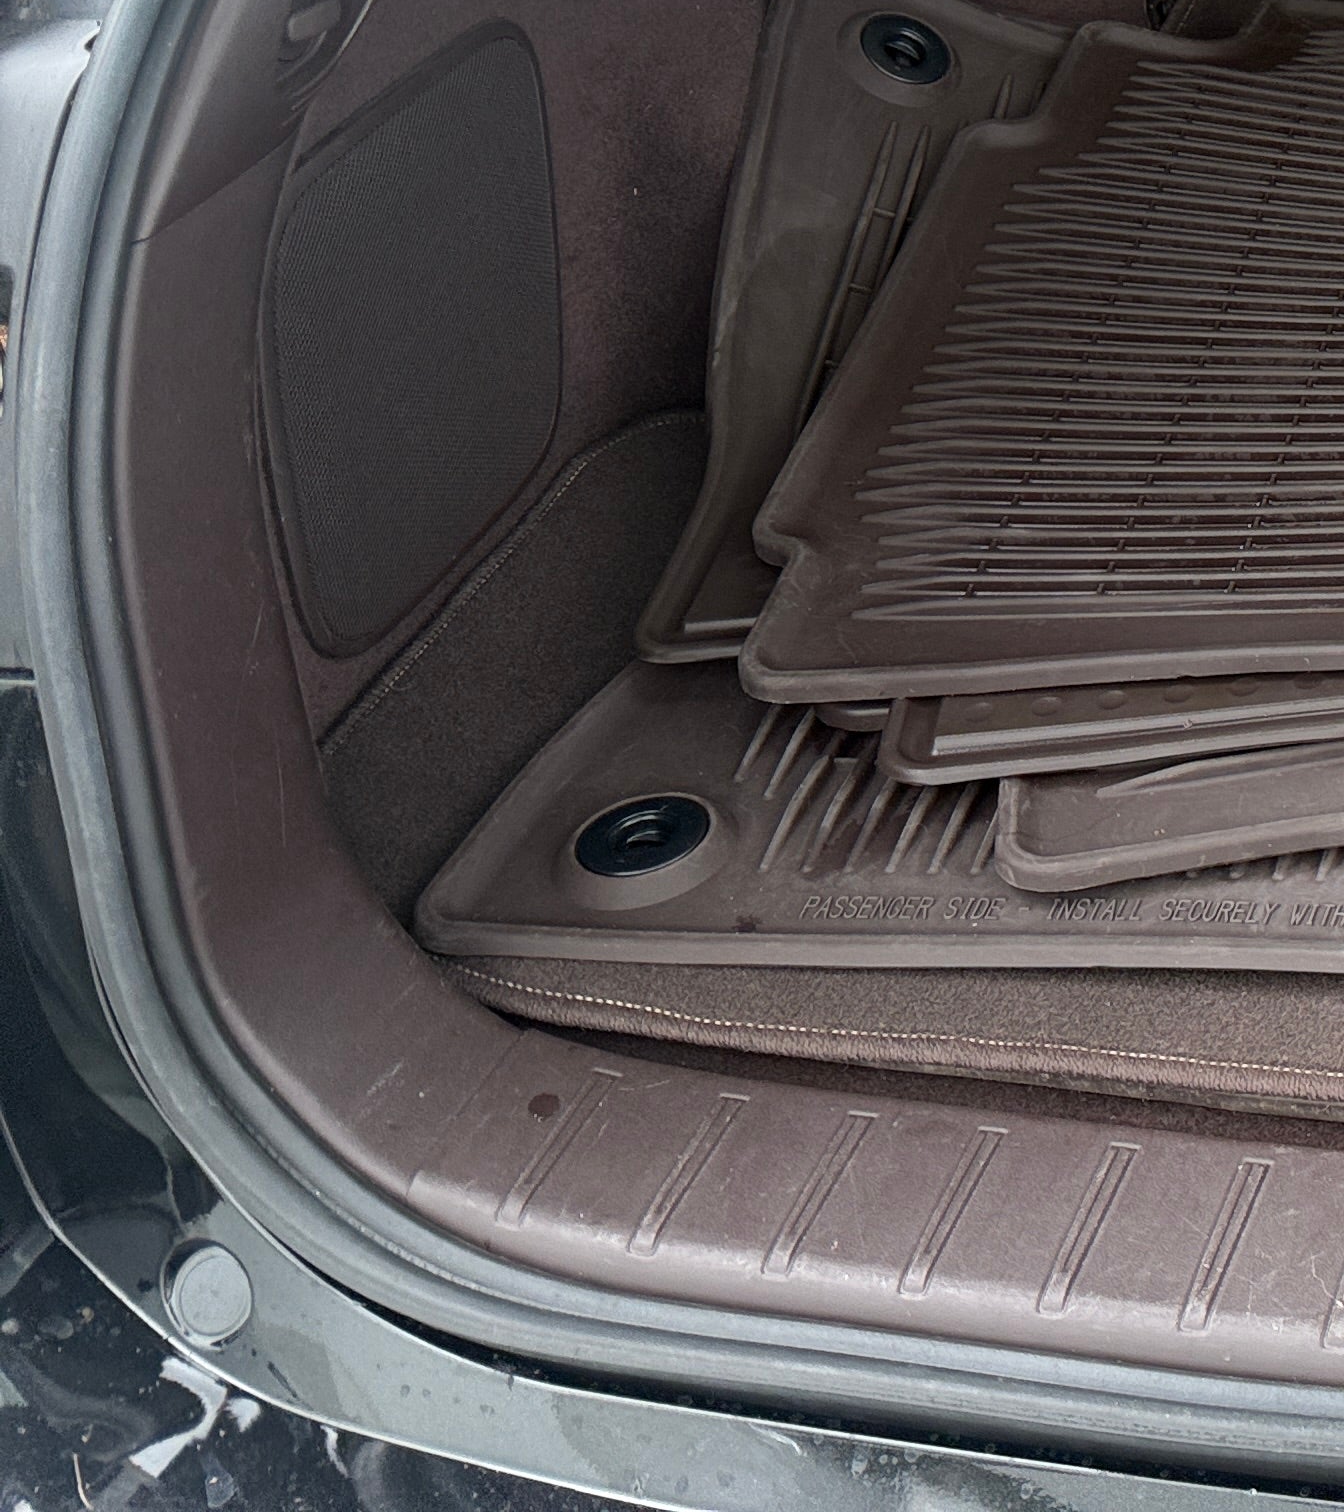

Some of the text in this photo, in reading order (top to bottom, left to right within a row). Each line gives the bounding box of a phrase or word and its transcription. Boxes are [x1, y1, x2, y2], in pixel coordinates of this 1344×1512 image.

[800, 896, 936, 921] PASSENGER
[943, 897, 1006, 921] SIDE
[1046, 897, 1142, 922] INSTALL
[1159, 898, 1279, 925] SECURELY
